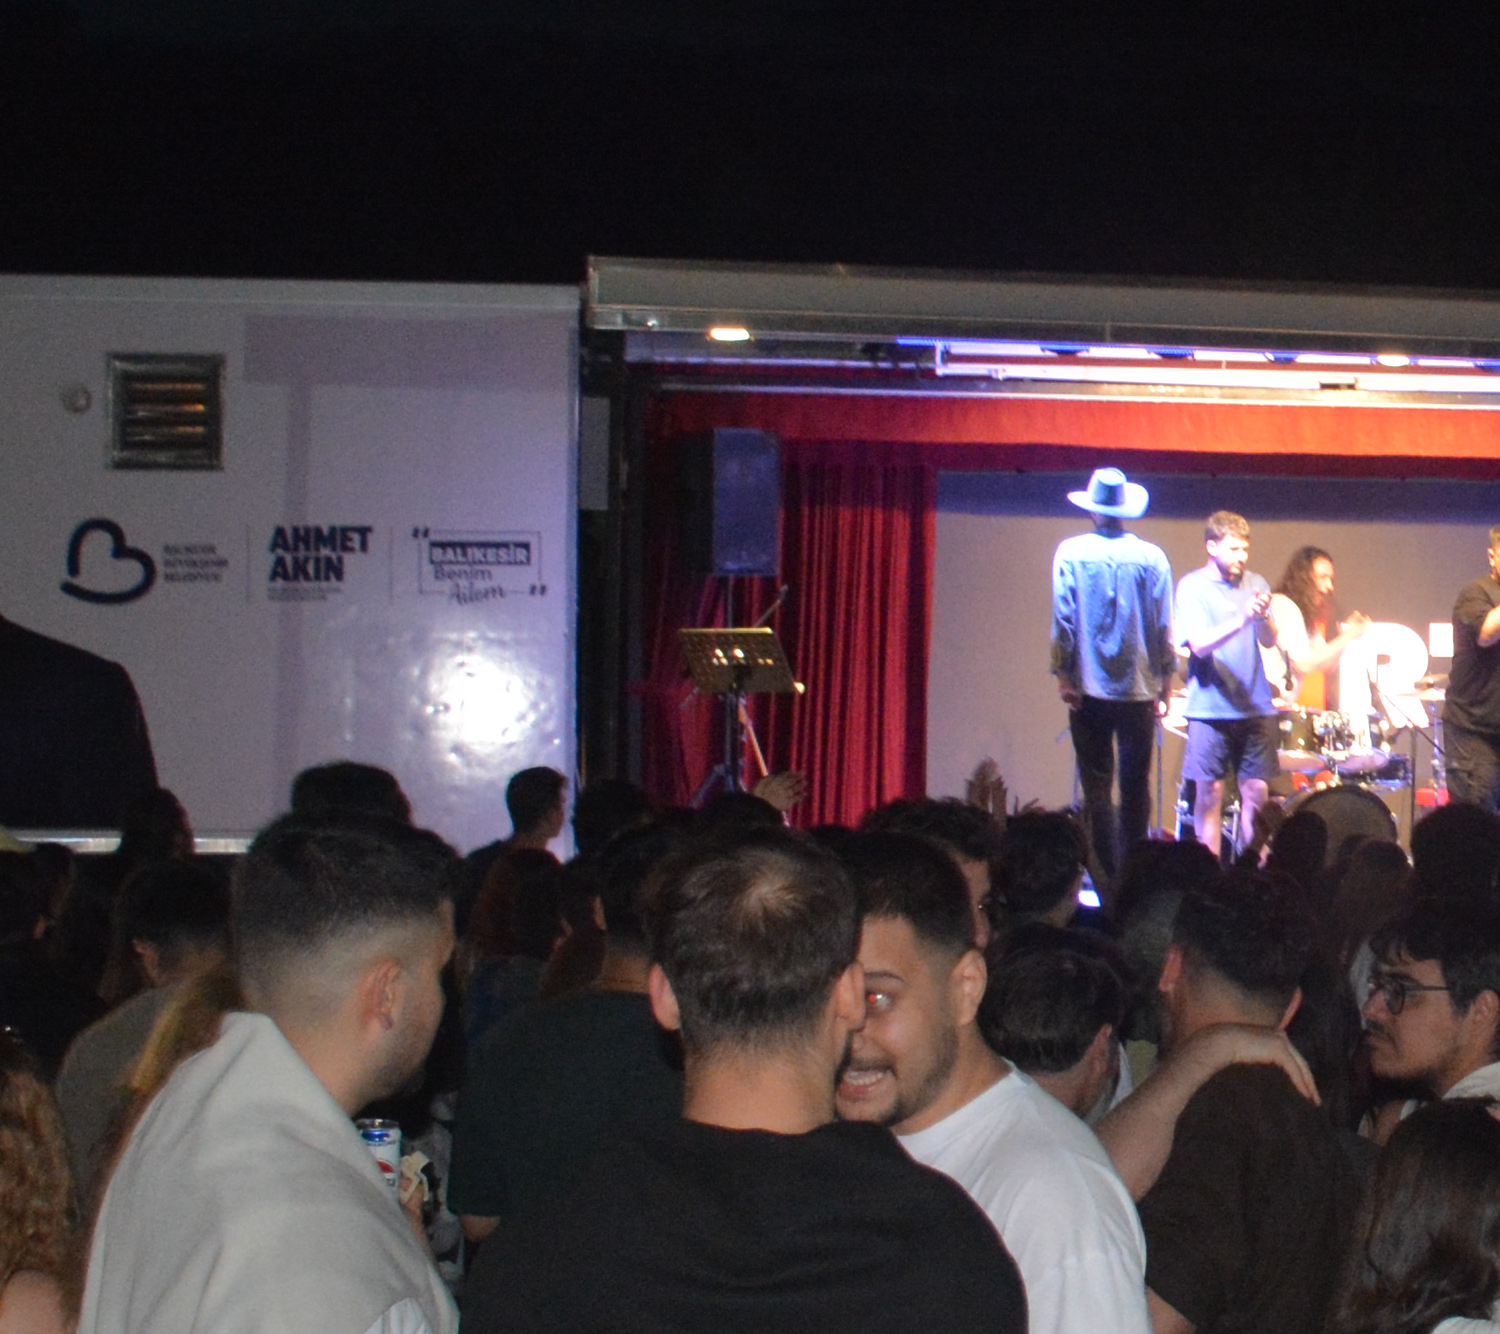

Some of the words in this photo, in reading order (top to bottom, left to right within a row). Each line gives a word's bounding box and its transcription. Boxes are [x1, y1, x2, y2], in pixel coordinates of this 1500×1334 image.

[269, 525, 373, 553] AHMET
[430, 543, 529, 564] BALIKESİR
[269, 555, 345, 582] AKIN
[433, 564, 493, 581] Benim
